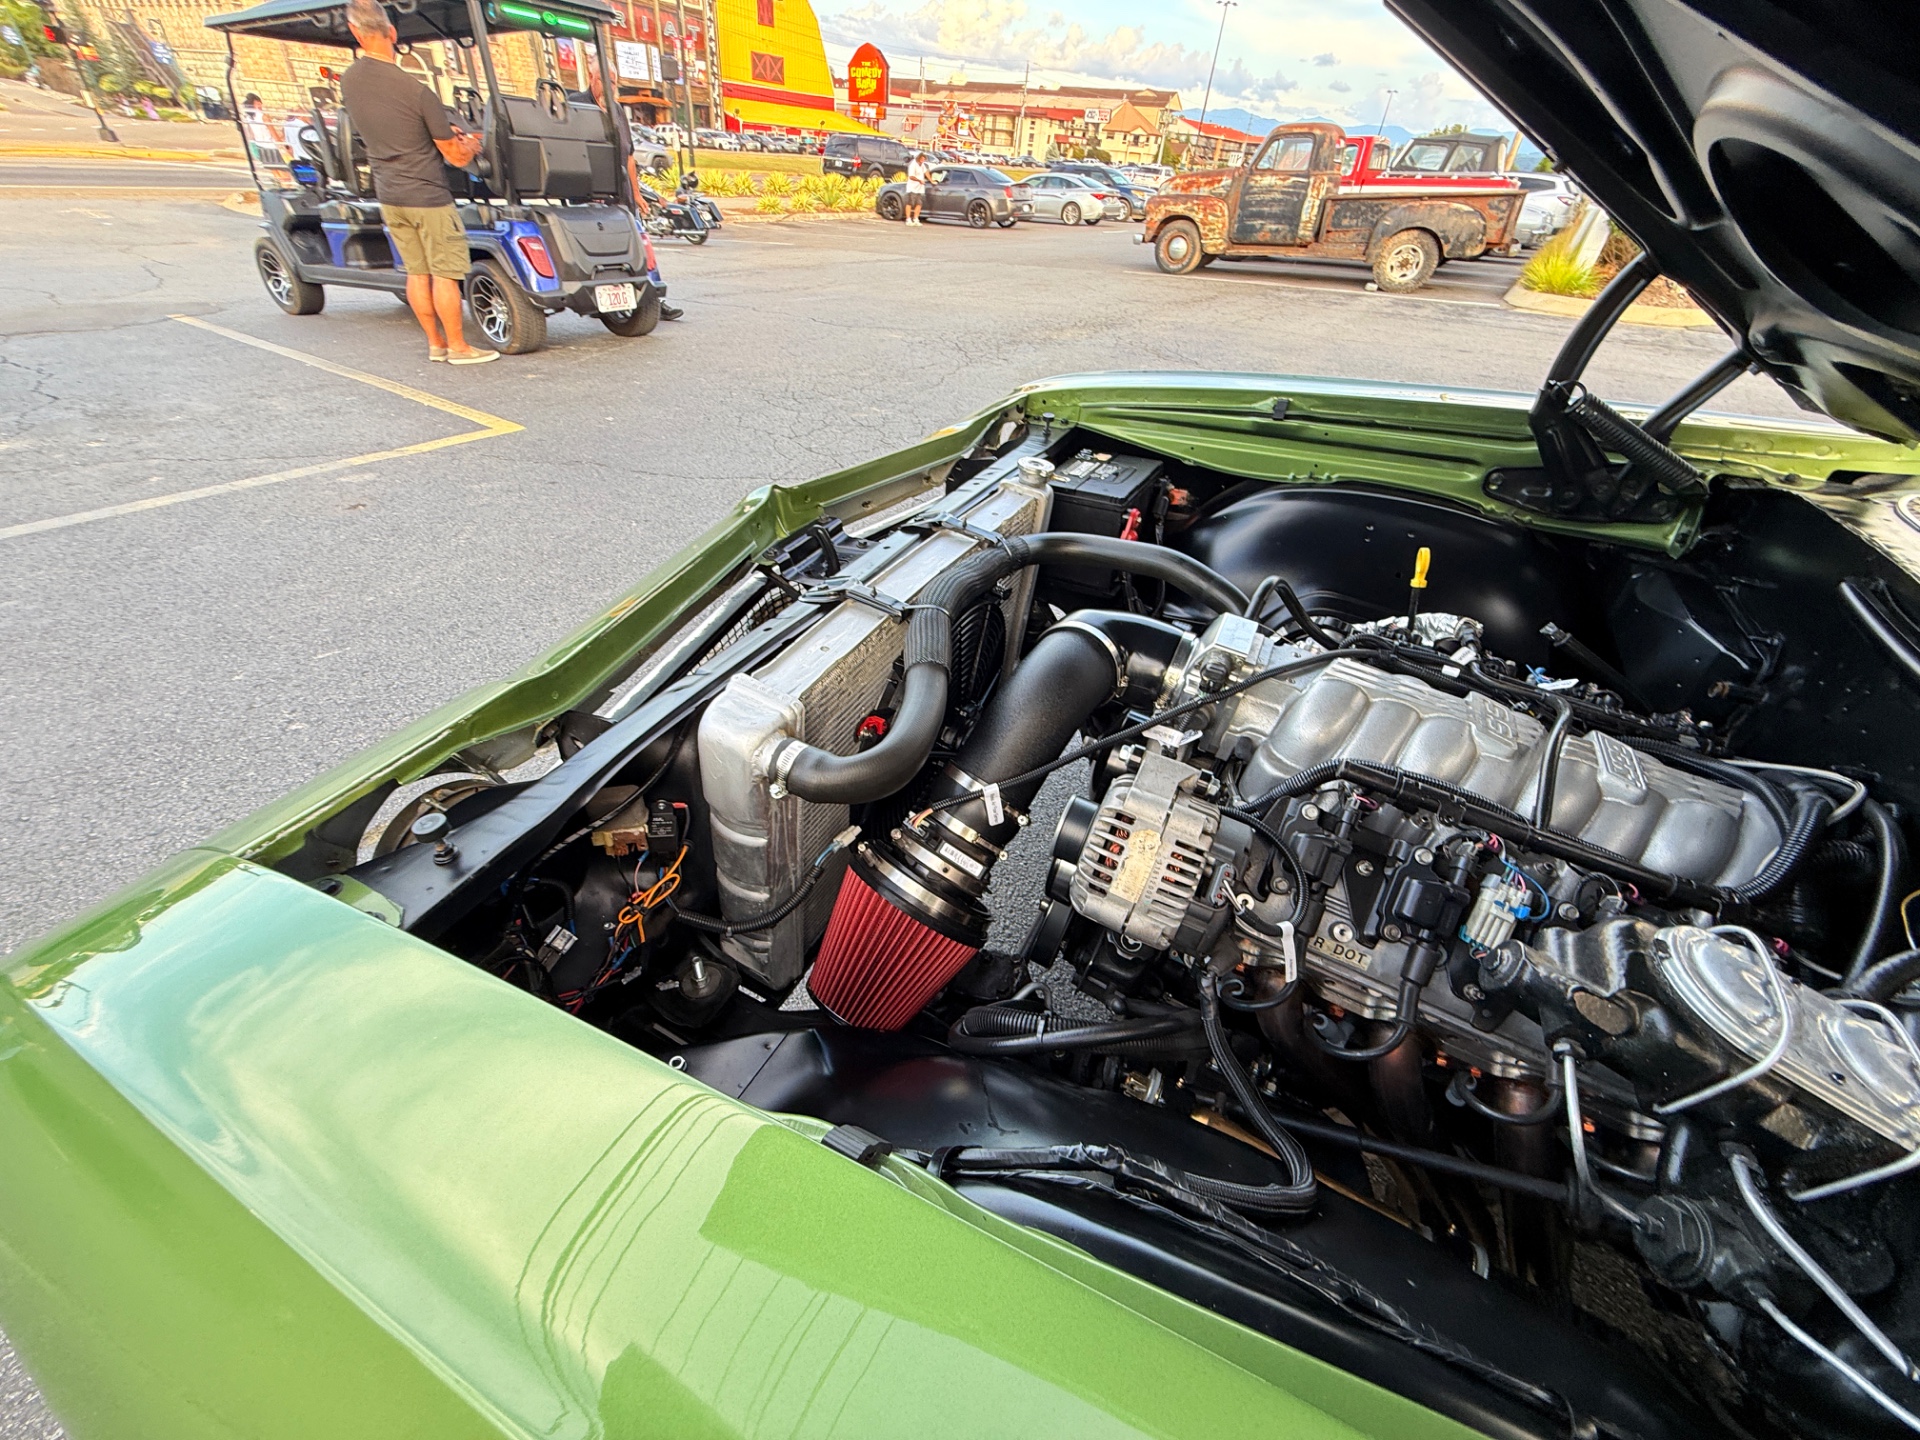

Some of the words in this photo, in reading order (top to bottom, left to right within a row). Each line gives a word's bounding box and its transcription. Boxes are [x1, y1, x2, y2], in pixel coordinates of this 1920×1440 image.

[850, 67, 882, 79] COMEDY
[856, 78, 877, 90] BARN
[1333, 943, 1368, 964] DOT
